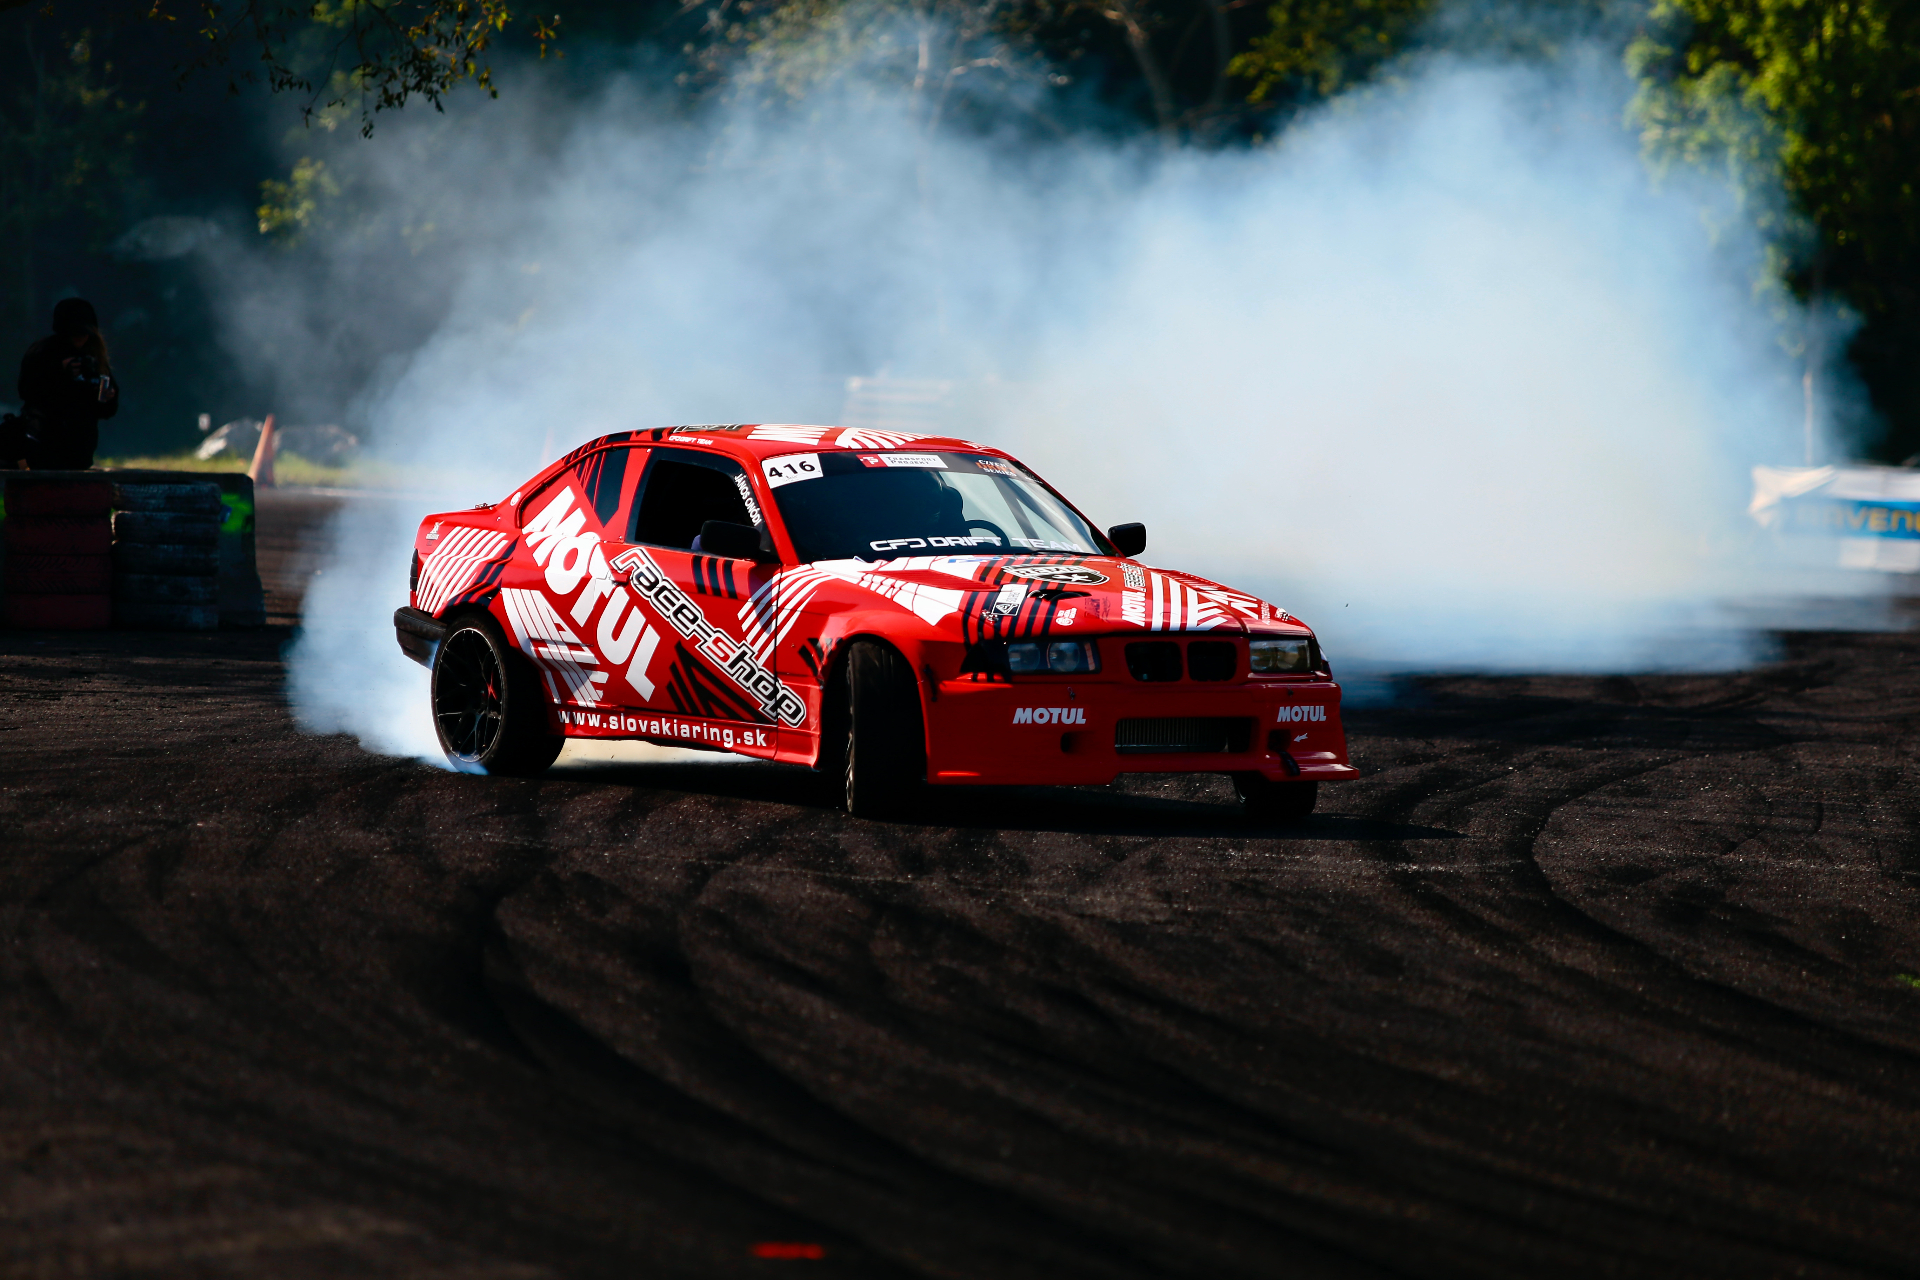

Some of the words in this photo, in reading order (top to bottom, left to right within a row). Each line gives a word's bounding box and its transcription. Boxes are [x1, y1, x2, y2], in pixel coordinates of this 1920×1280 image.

[768, 460, 816, 478] 416
[734, 472, 751, 500] JÁNOS
[745, 497, 762, 527] ONÓDI
[926, 536, 1003, 547] DRIFT
[1011, 537, 1083, 551] TEAM
[521, 485, 661, 702] MOTUL
[1121, 590, 1146, 627] MOTUL
[609, 547, 807, 728] race-shop
[557, 710, 767, 748] www.slovakiaring.sk
[1012, 707, 1087, 725] MOTUL
[1276, 705, 1327, 723] MOTUL
